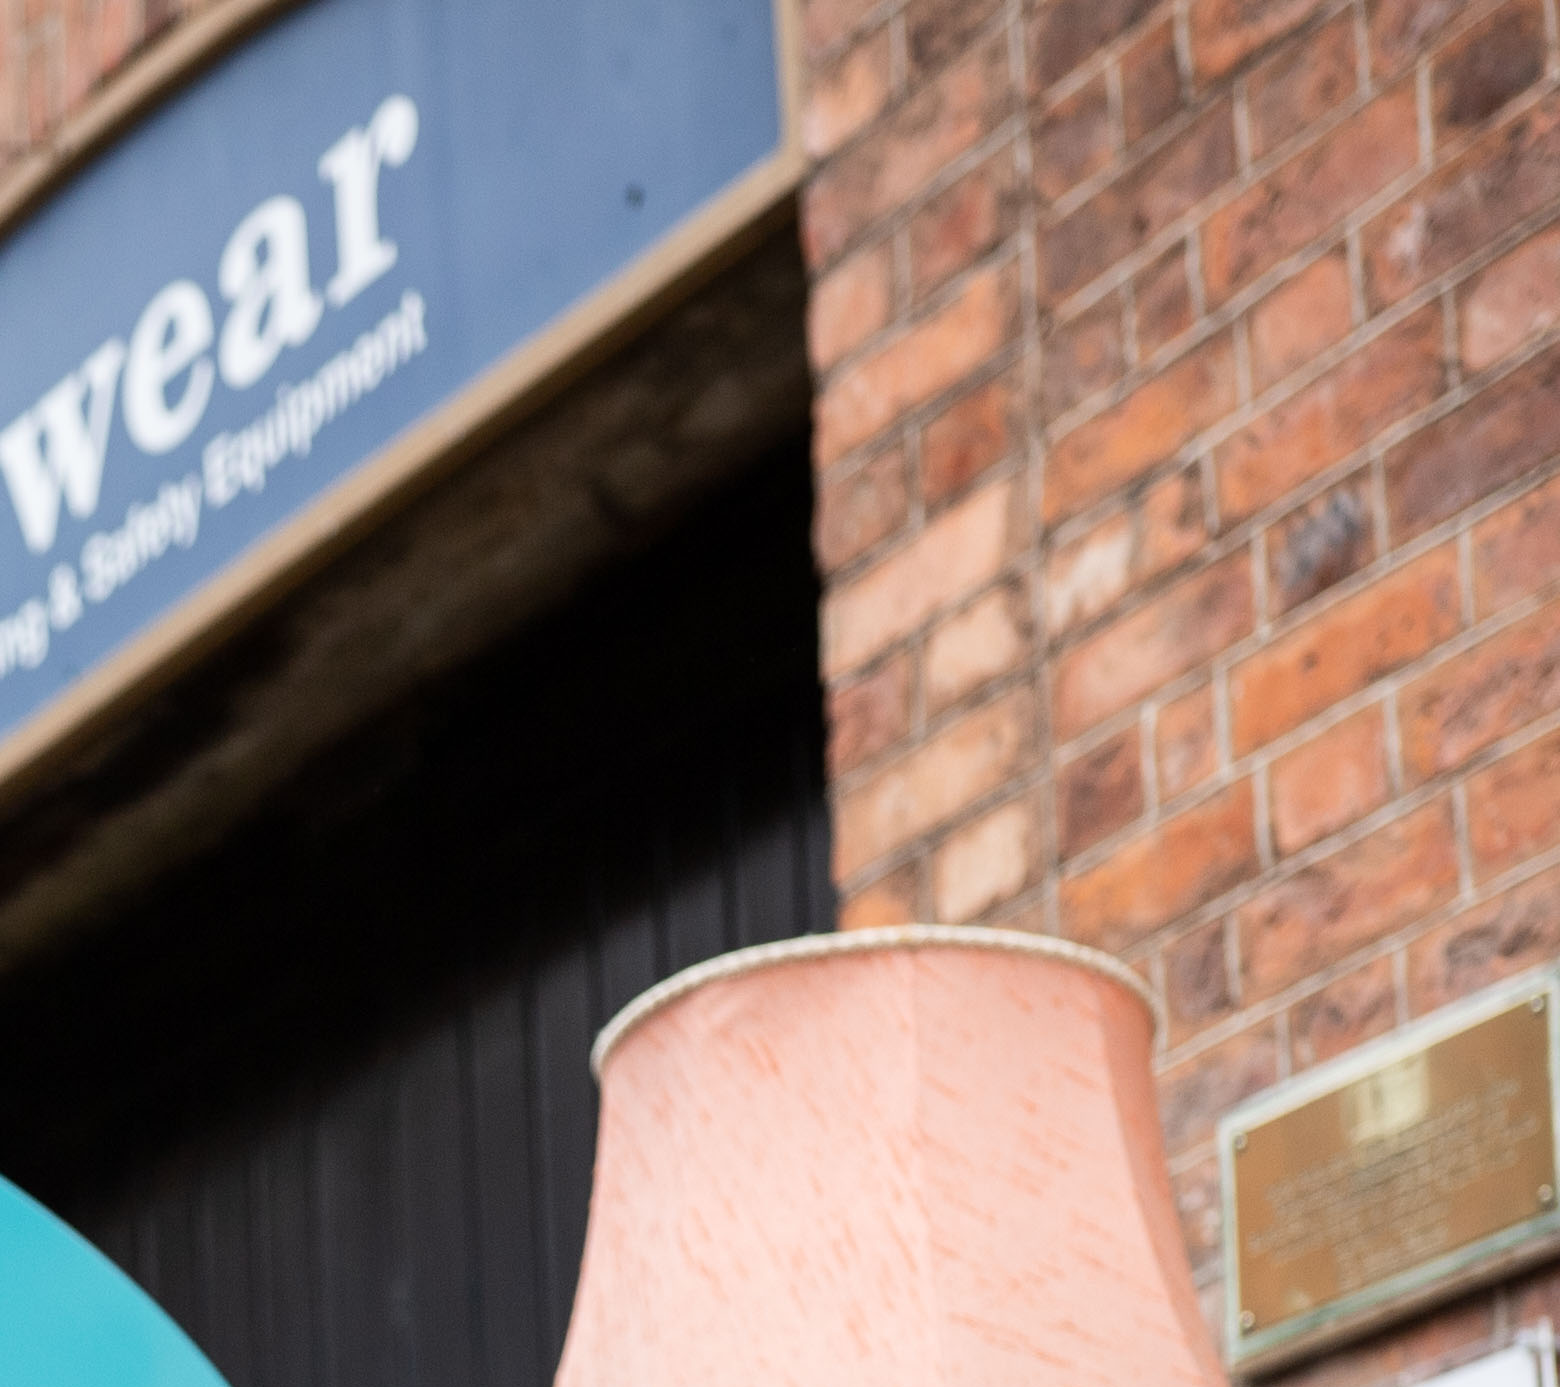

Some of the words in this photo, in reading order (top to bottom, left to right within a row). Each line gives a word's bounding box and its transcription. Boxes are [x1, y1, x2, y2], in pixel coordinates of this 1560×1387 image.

[46, 562, 83, 632] &
[81, 471, 204, 604] Safety
[202, 286, 428, 509] Equipment
